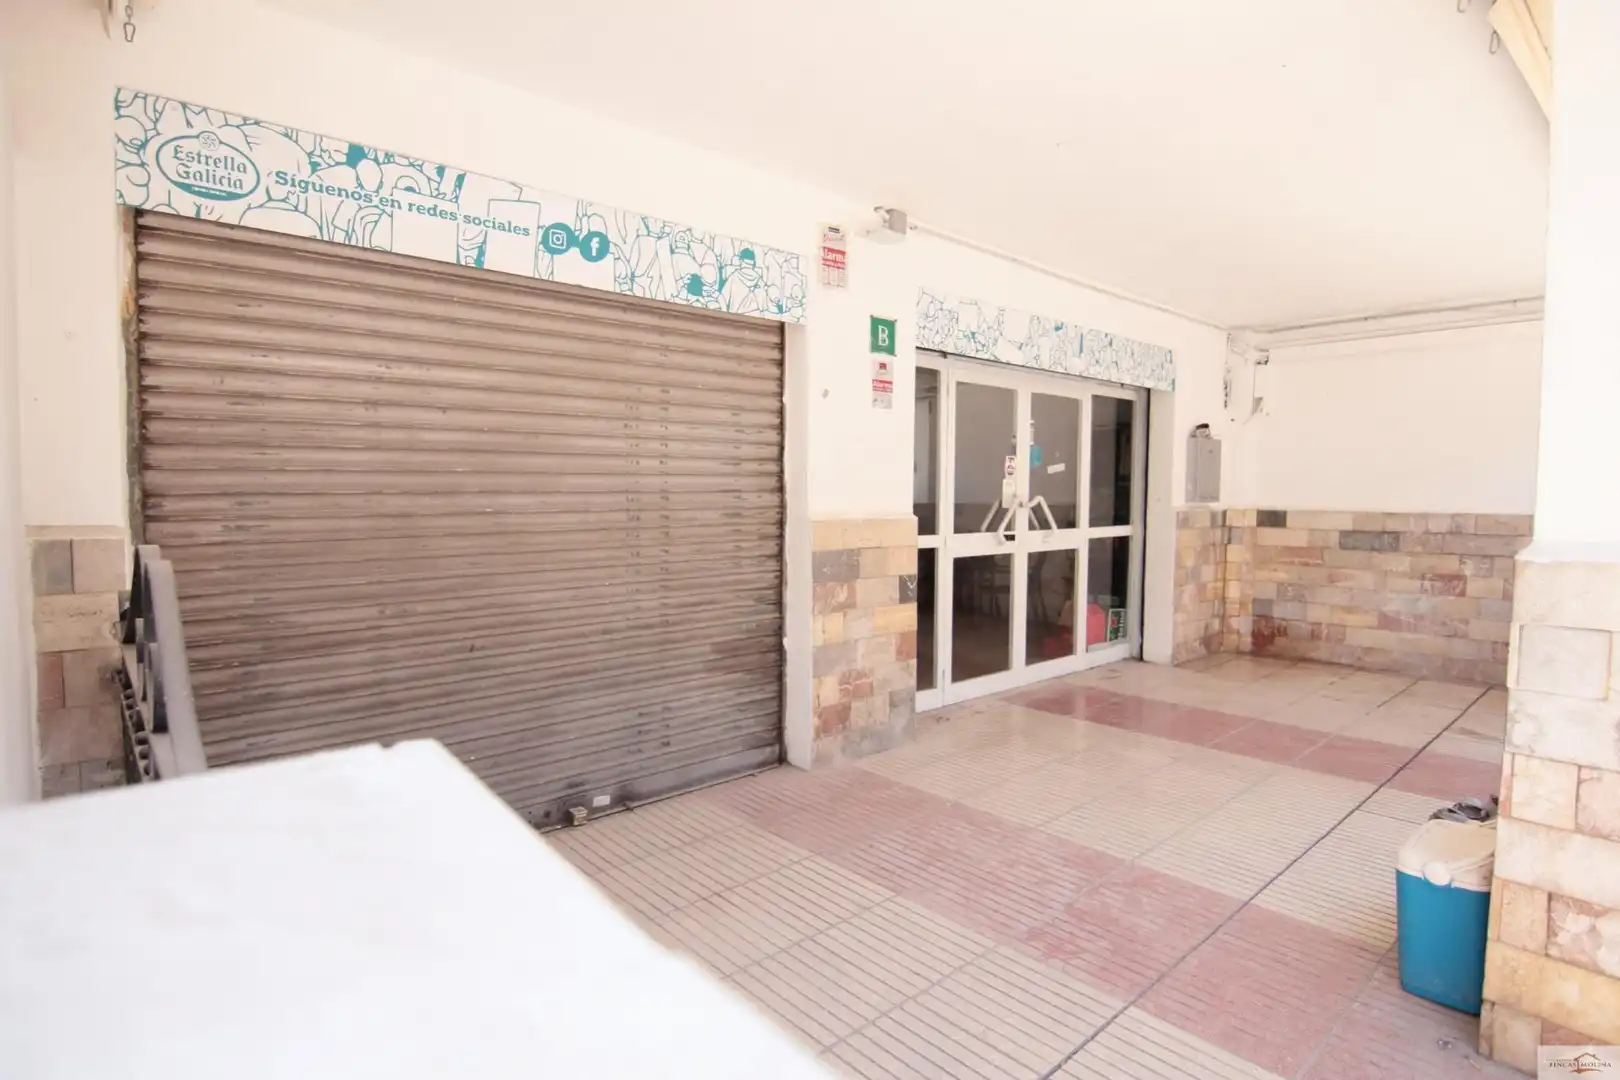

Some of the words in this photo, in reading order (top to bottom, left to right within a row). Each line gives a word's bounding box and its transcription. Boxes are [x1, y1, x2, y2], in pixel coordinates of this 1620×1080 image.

[172, 144, 248, 174] Estrella
[175, 163, 244, 191] Galicia
[274, 170, 374, 204] Síguenos
[379, 194, 402, 211] en
[407, 200, 458, 222] redes
[463, 212, 531, 237] sociales
[877, 325, 889, 347] B
